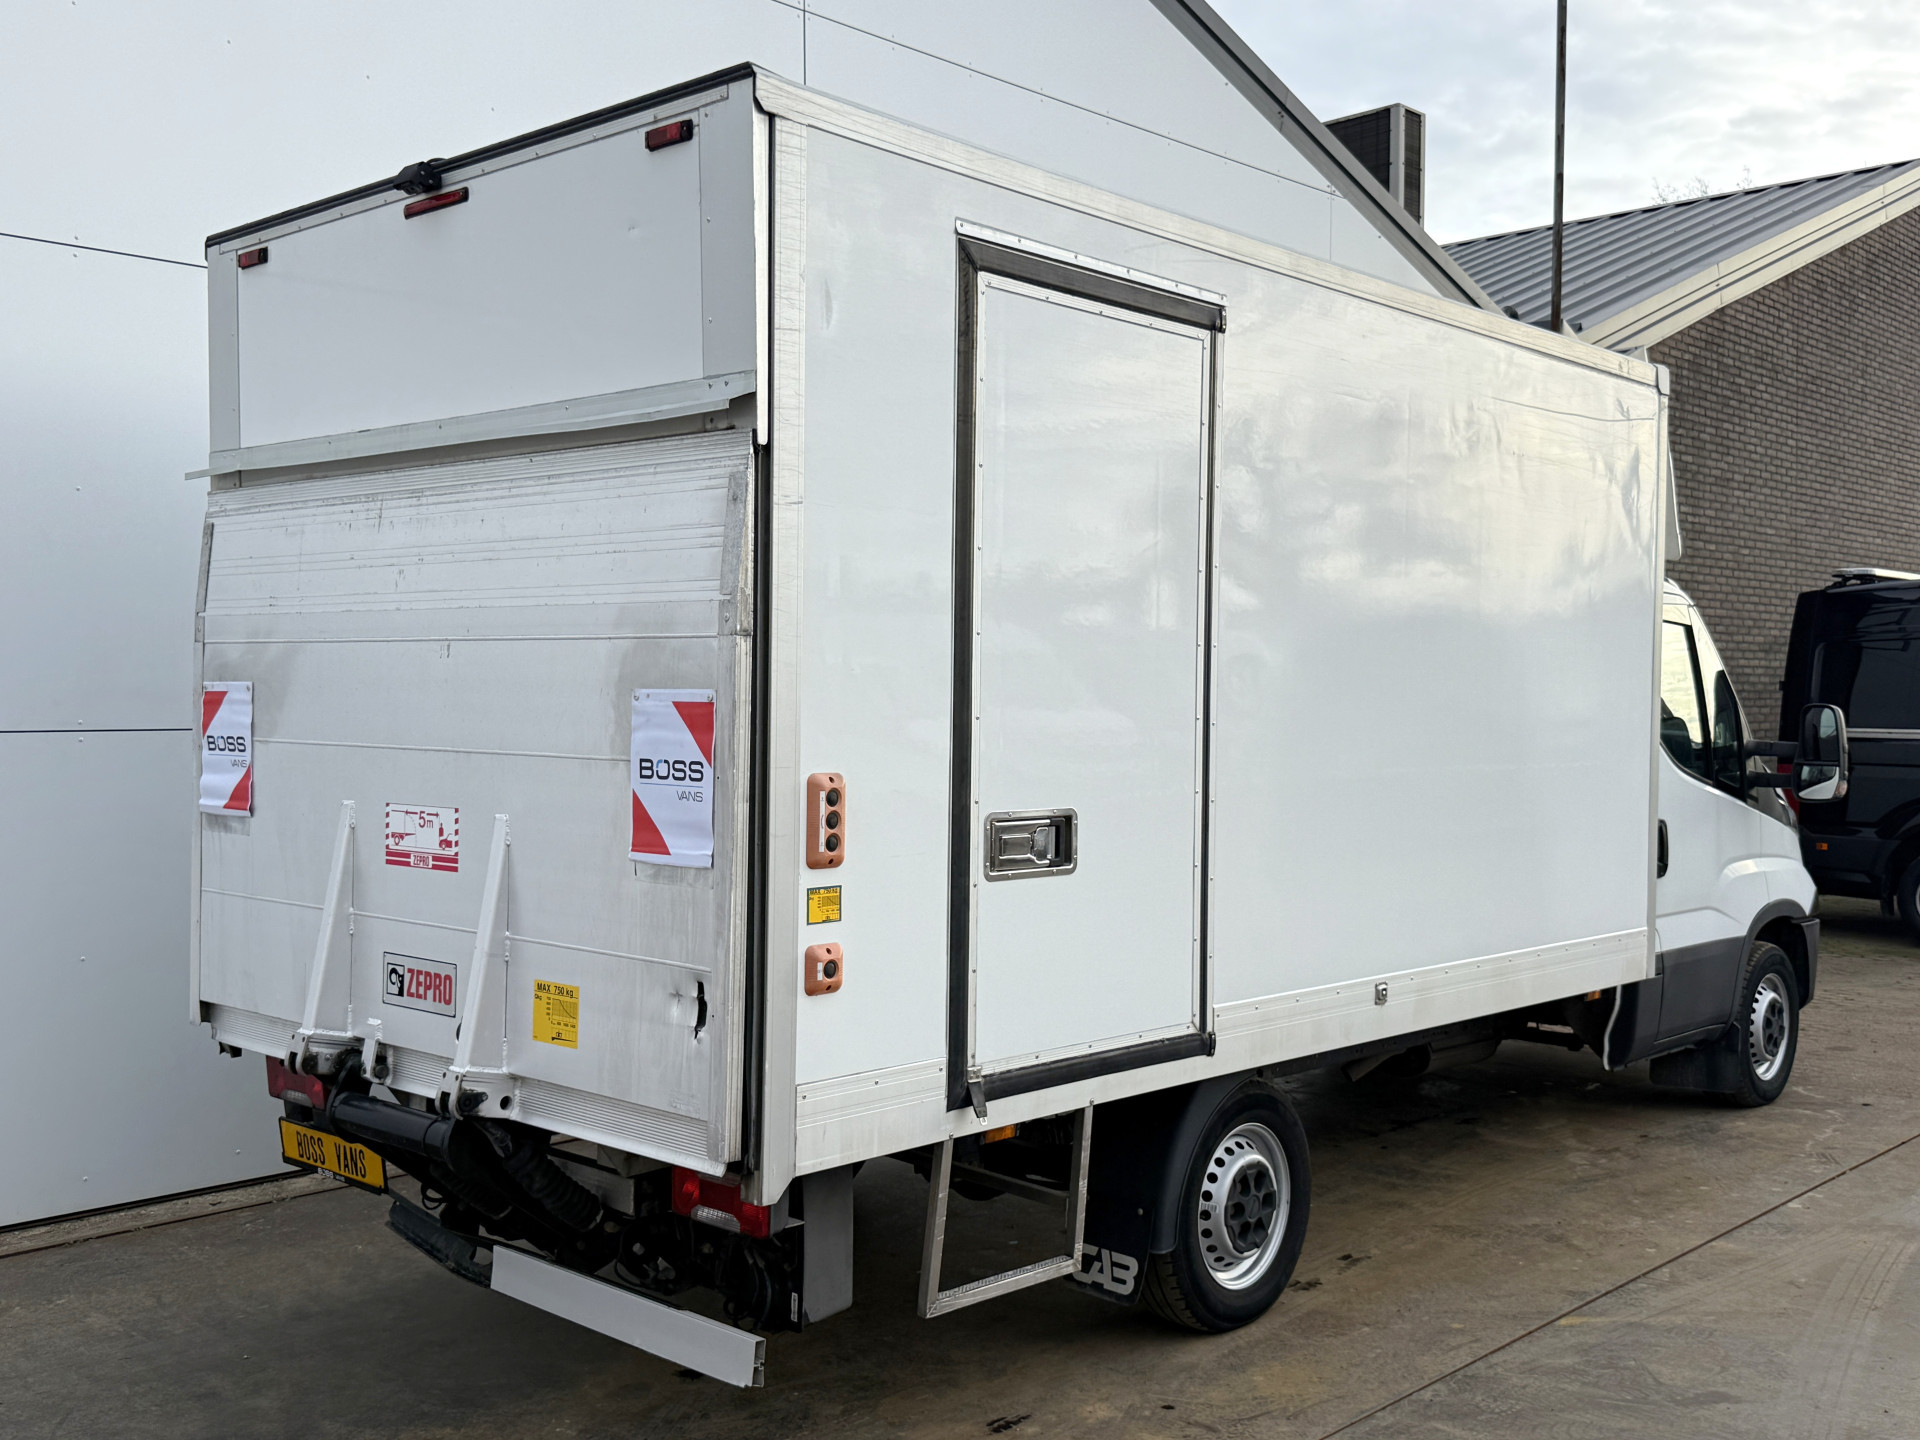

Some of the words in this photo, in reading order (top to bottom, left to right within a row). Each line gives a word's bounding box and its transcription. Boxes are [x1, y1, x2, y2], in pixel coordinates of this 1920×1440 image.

[207, 735, 247, 752] BOSS
[230, 759, 248, 768] VANS
[639, 758, 704, 782] BOSS
[676, 790, 704, 802] VANS
[412, 854, 430, 867] ZEPRO
[406, 967, 453, 1006] ZEPRO
[537, 982, 551, 993] MAX
[553, 985, 565, 995] 750
[565, 987, 574, 999] kg
[296, 1130, 326, 1166] BOSS
[334, 1142, 367, 1179] VANS
